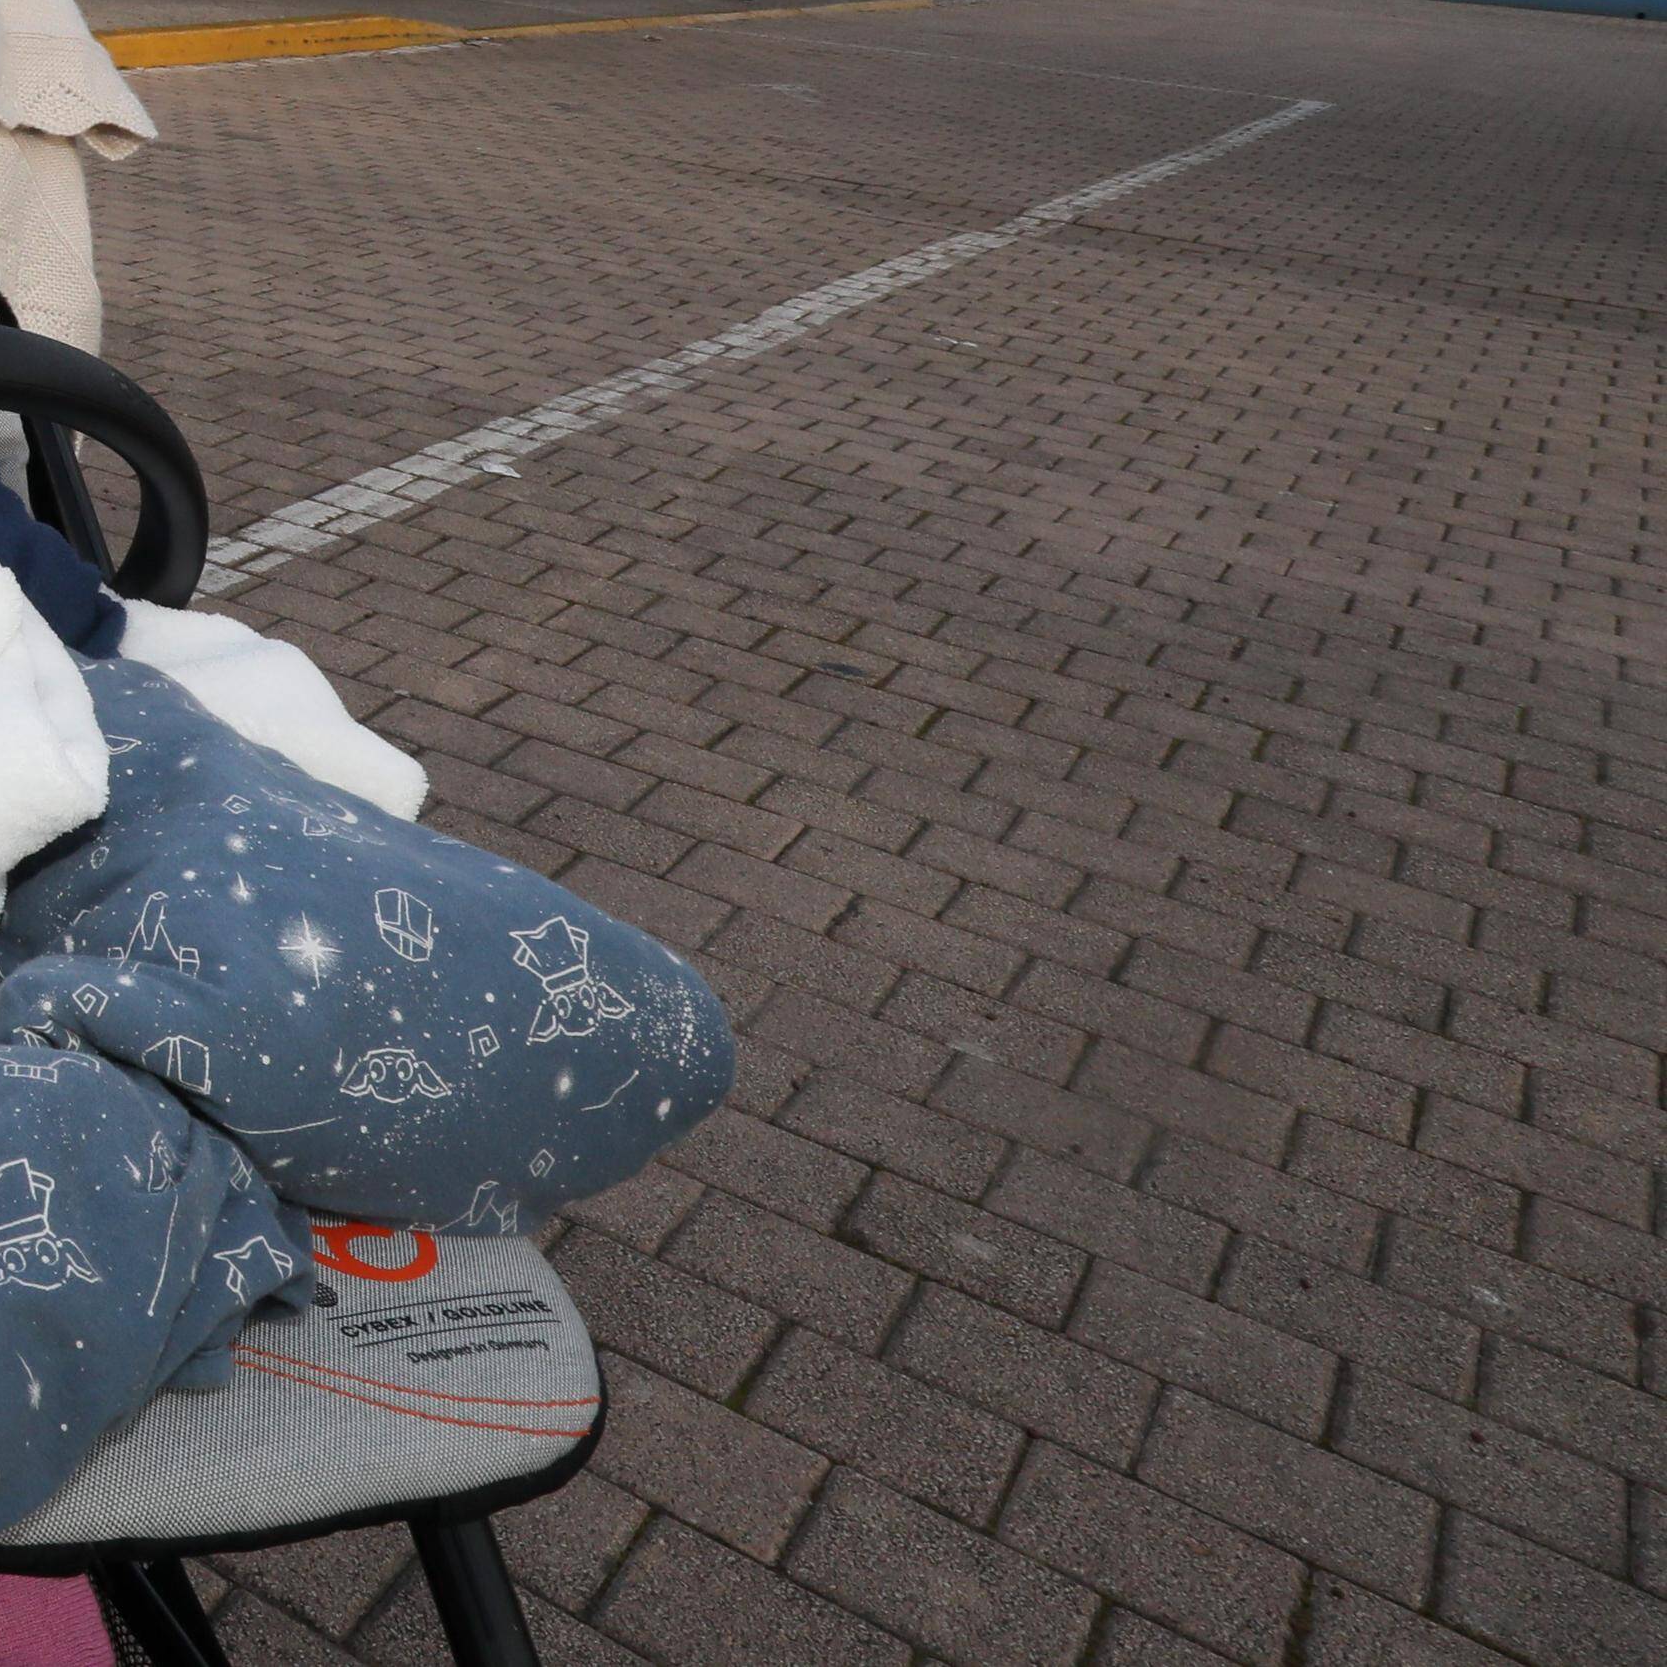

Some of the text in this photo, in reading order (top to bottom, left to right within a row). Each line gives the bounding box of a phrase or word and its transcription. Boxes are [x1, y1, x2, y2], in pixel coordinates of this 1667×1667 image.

[340, 1314, 419, 1338] CYBEX
[442, 1300, 552, 1322] GOLDLINE
[407, 1336, 550, 1364] Designed in Germany
